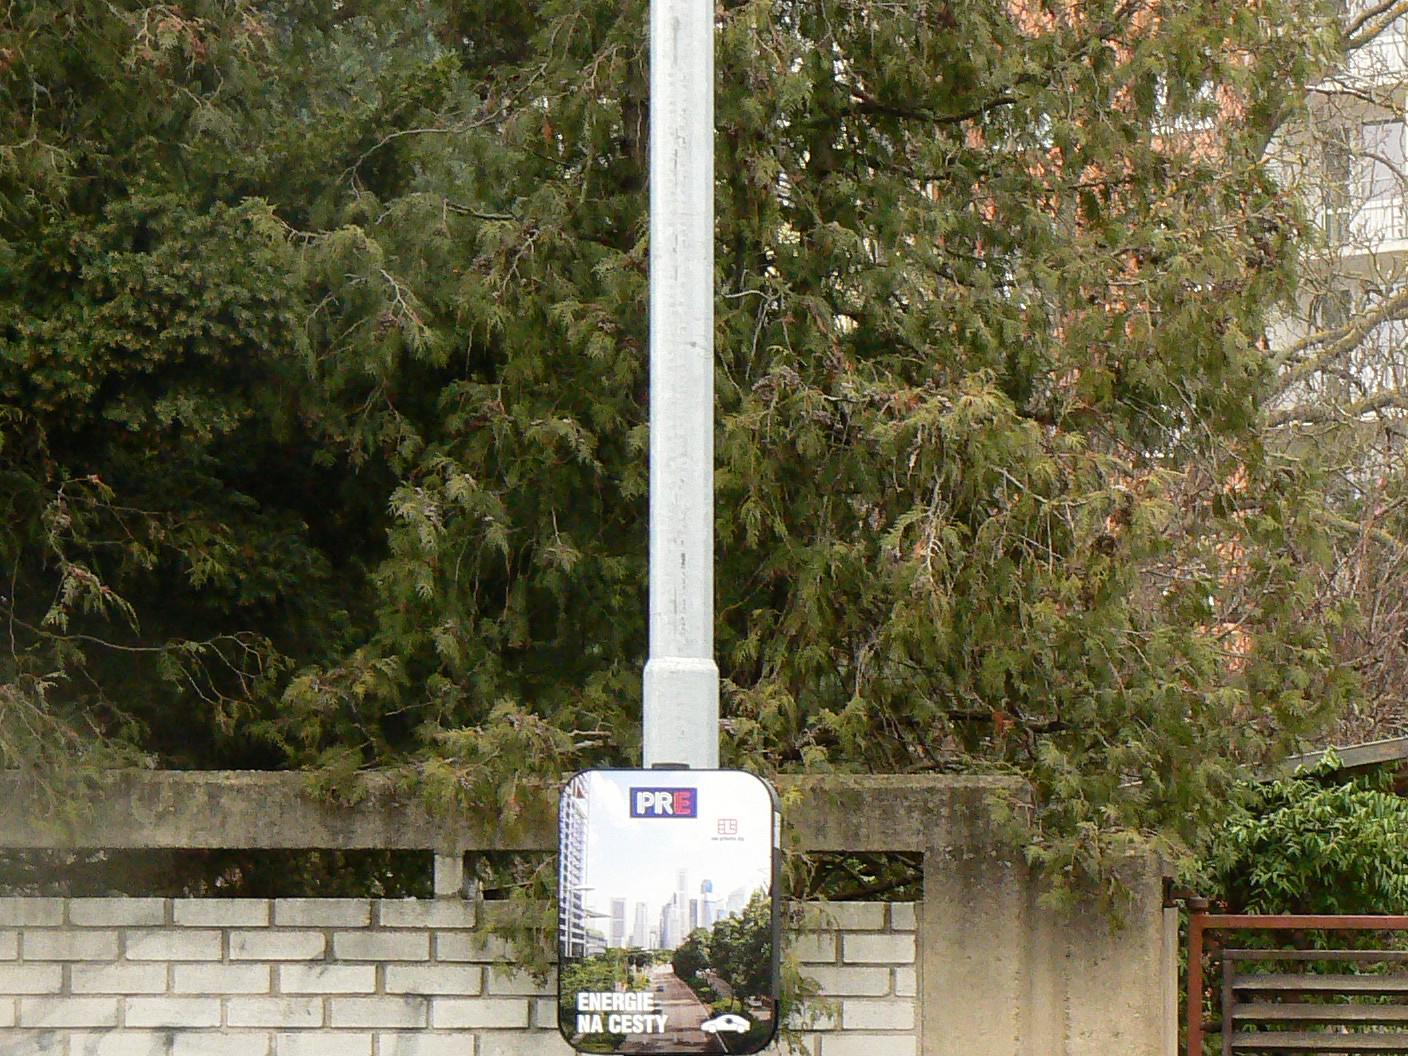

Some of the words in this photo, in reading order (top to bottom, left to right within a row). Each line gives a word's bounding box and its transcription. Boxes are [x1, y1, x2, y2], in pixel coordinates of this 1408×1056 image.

[636, 791, 691, 815] PRE
[577, 992, 655, 1011] ENERGIE
[577, 1014, 604, 1033] NA
[608, 1014, 669, 1034] CESTY
